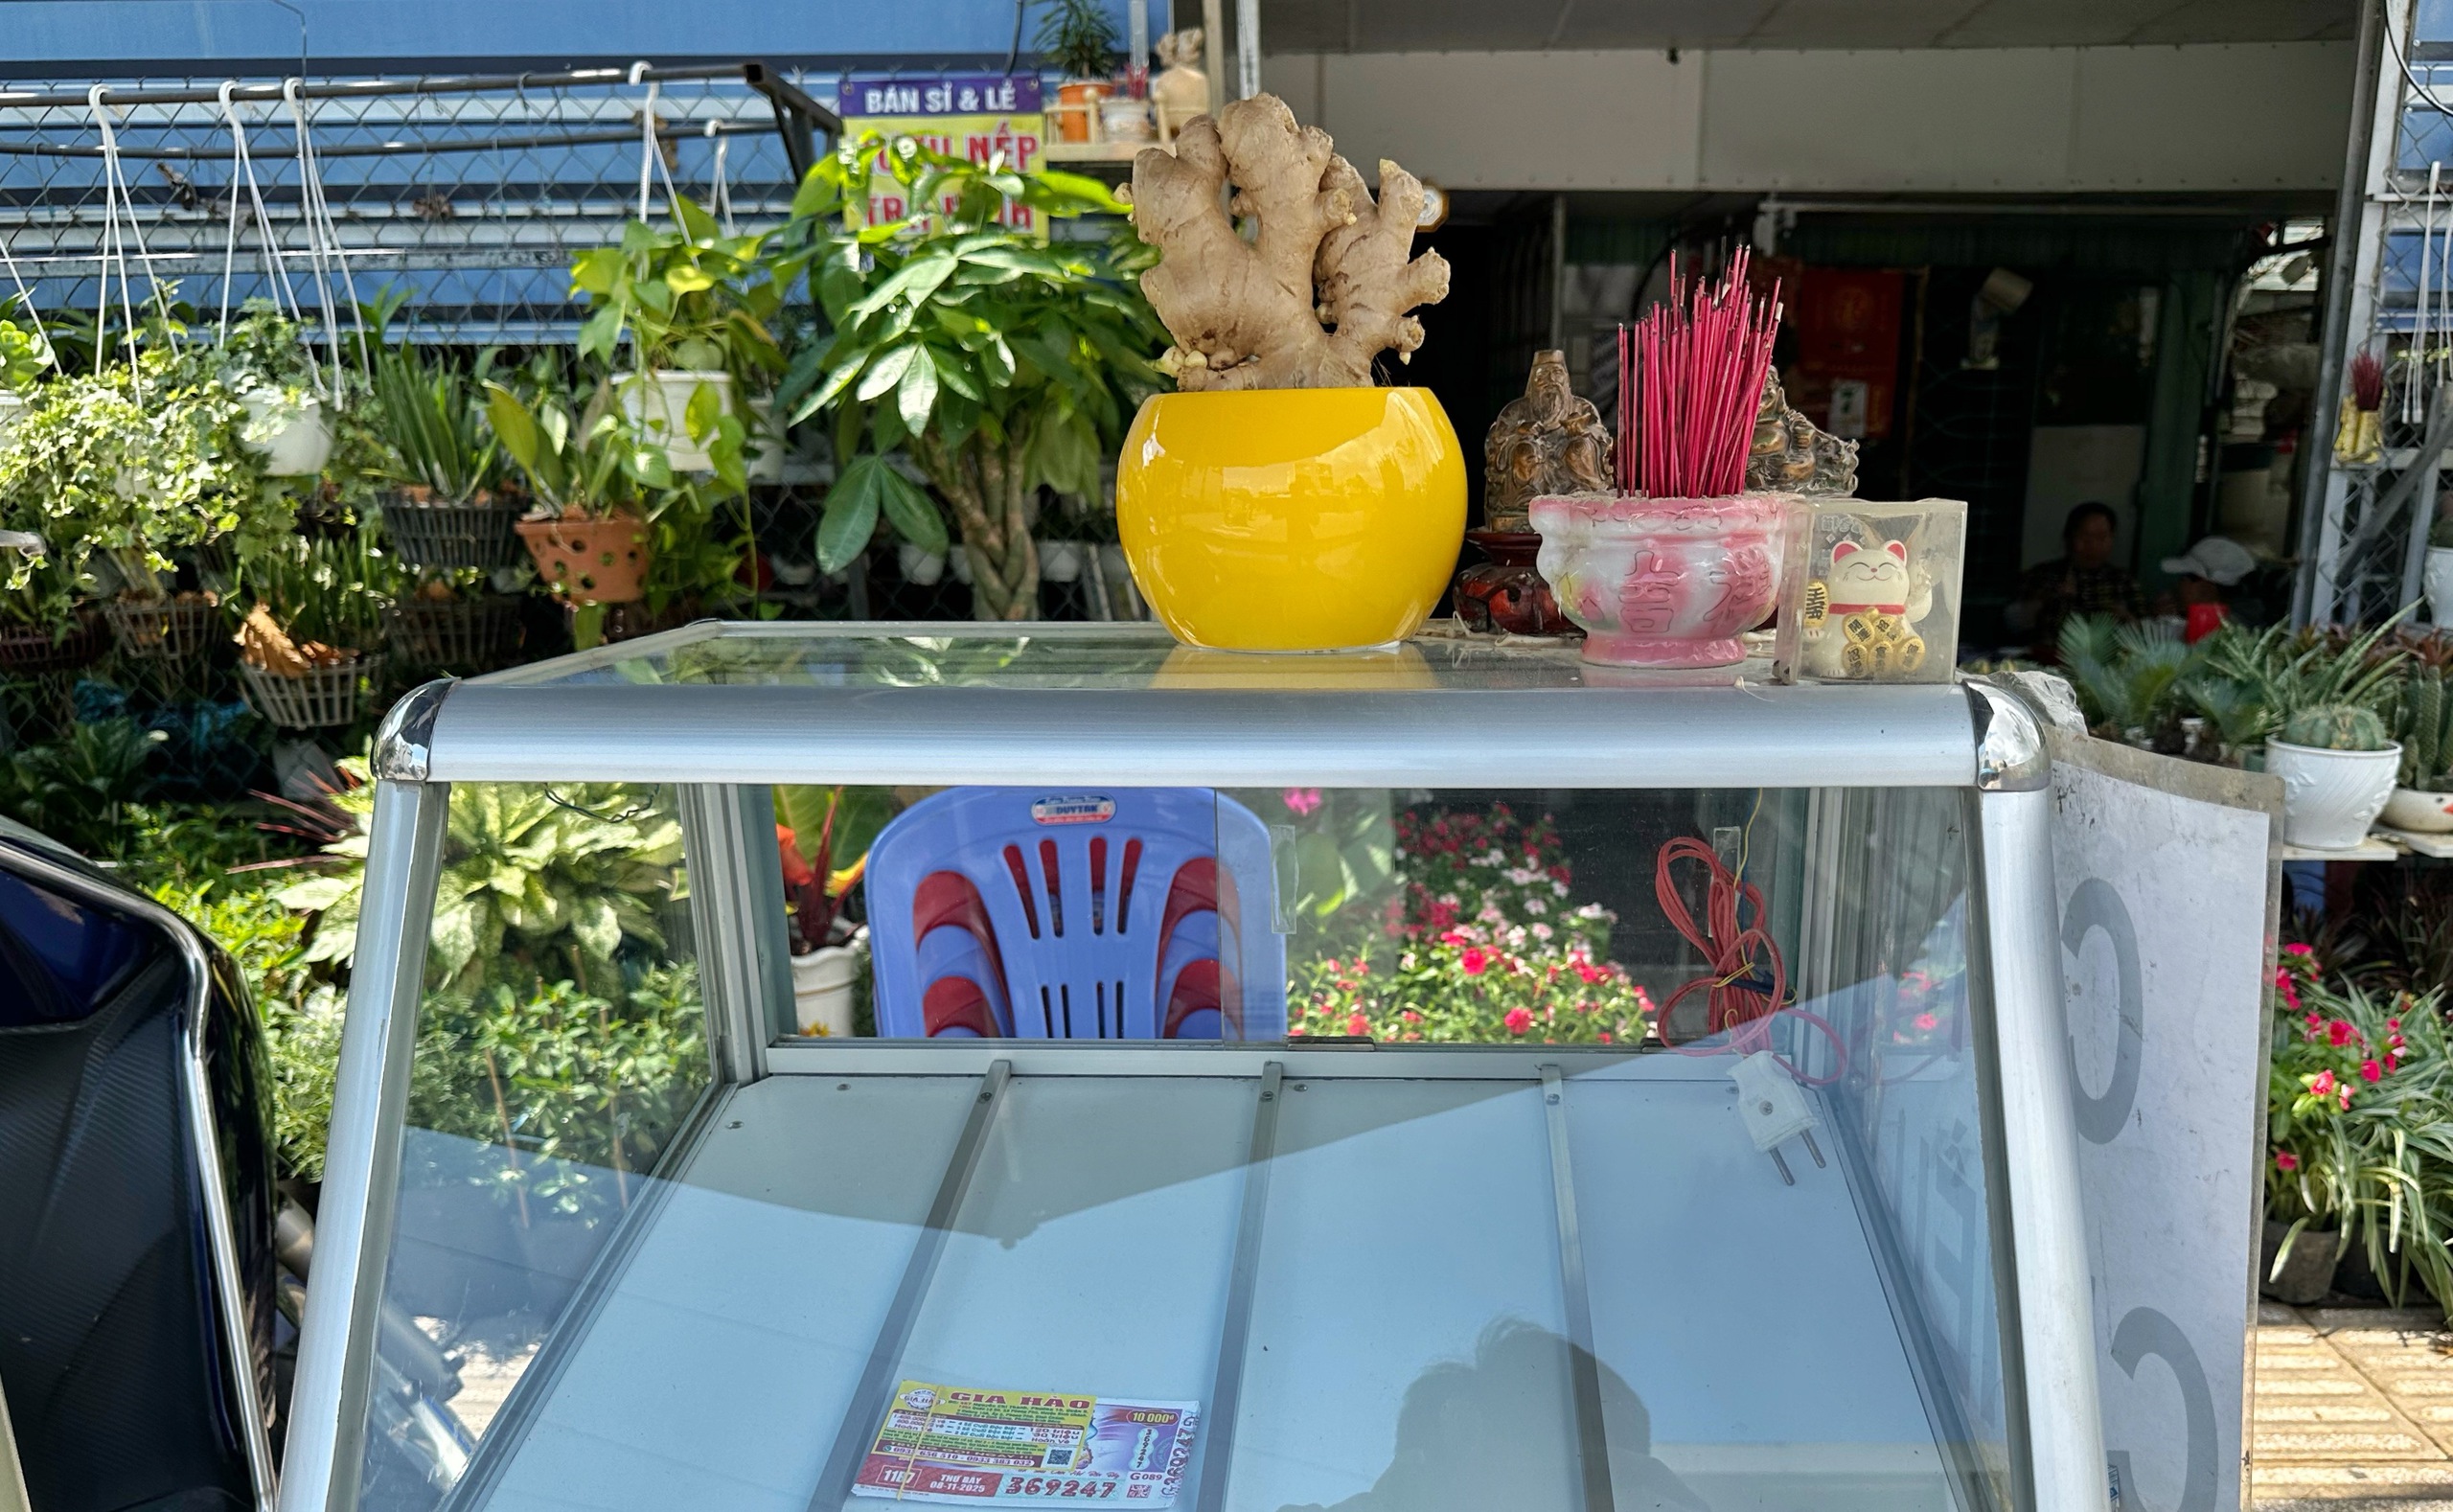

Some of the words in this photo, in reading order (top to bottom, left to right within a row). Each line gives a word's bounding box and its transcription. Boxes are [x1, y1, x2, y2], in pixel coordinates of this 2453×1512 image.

[864, 84, 920, 113] BÁN
[958, 86, 979, 111] &
[984, 79, 1017, 110] LẺ
[951, 1392, 1006, 1404] GIA
[1142, 1473, 1163, 1481] 089
[929, 1481, 986, 1493] 08-11-2025
[1005, 1477, 1116, 1499] 369247
